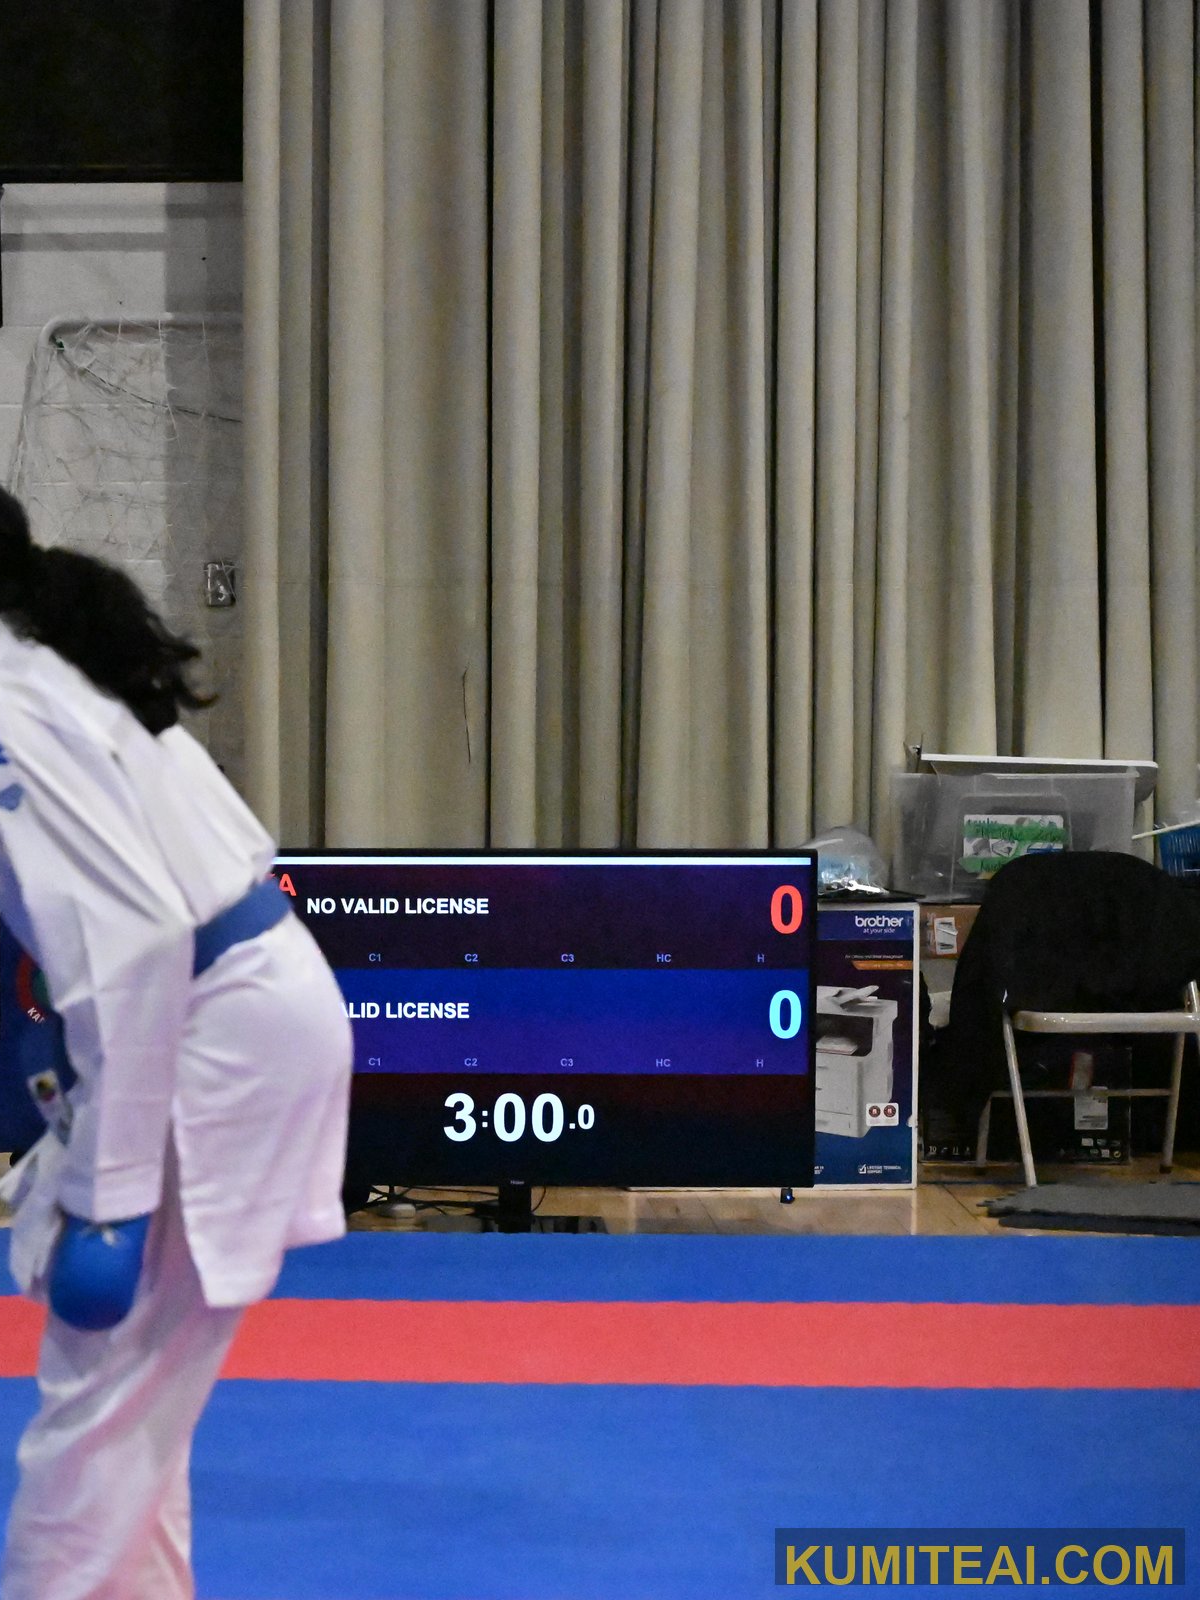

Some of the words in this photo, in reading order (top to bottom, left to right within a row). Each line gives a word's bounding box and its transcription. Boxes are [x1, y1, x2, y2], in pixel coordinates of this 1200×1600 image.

[307, 897, 336, 915] NO
[341, 897, 400, 915] VALID
[404, 897, 490, 915] LICENSE
[770, 884, 803, 935] 0
[854, 915, 904, 928] brother
[368, 953, 381, 962] C1
[464, 953, 478, 962] C2
[560, 953, 574, 962] C3
[656, 953, 672, 962] HC
[757, 953, 765, 962] H
[341, 1002, 380, 1019] LID
[385, 1002, 470, 1019] LICENSE
[769, 989, 802, 1040] 0
[368, 1057, 380, 1066] C1
[464, 1057, 478, 1066] C2
[560, 1057, 574, 1066] C3
[655, 1058, 671, 1067] HC
[756, 1058, 764, 1067] H
